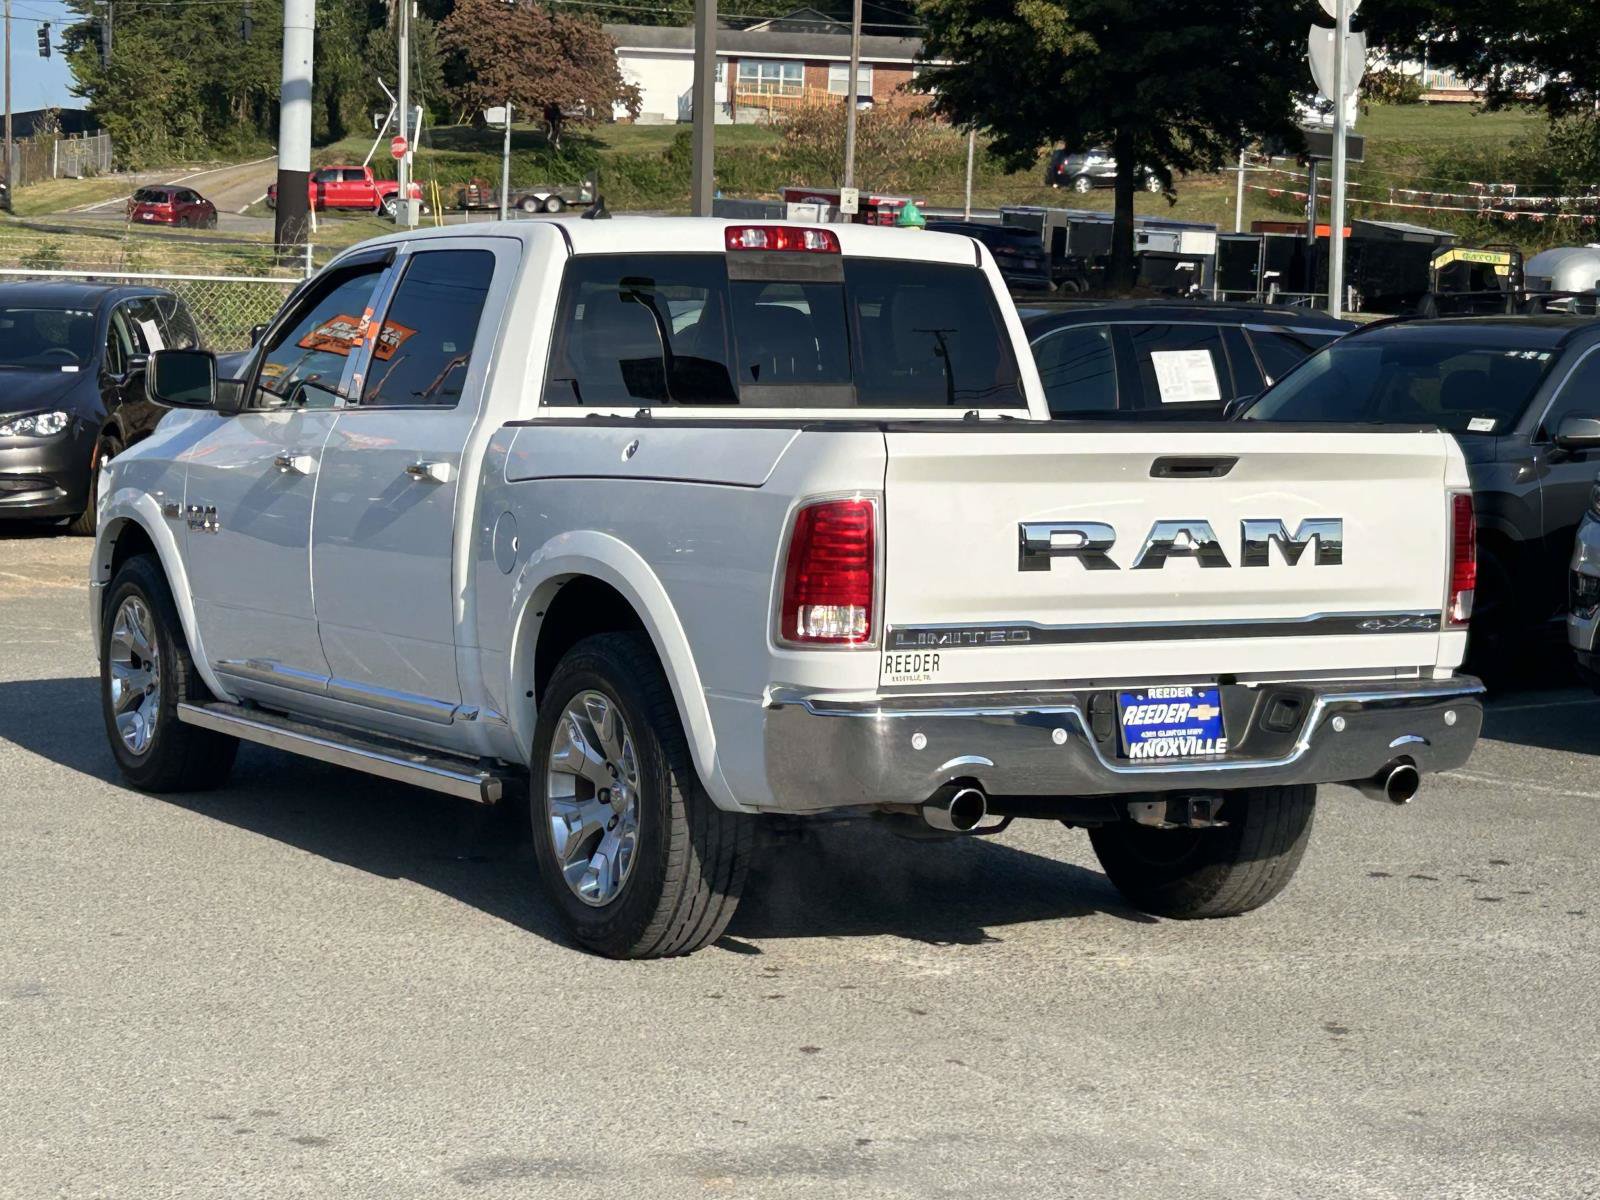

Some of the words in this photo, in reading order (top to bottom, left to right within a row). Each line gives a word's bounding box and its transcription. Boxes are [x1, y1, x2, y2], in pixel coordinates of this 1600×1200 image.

[1018, 518, 1343, 571] RAM
[895, 630, 1031, 645] LIMITED
[884, 653, 940, 674] REEDER
[1147, 687, 1194, 699] REEDER
[1122, 703, 1191, 726] REEDER
[1129, 738, 1228, 758] KNOXVILLE
